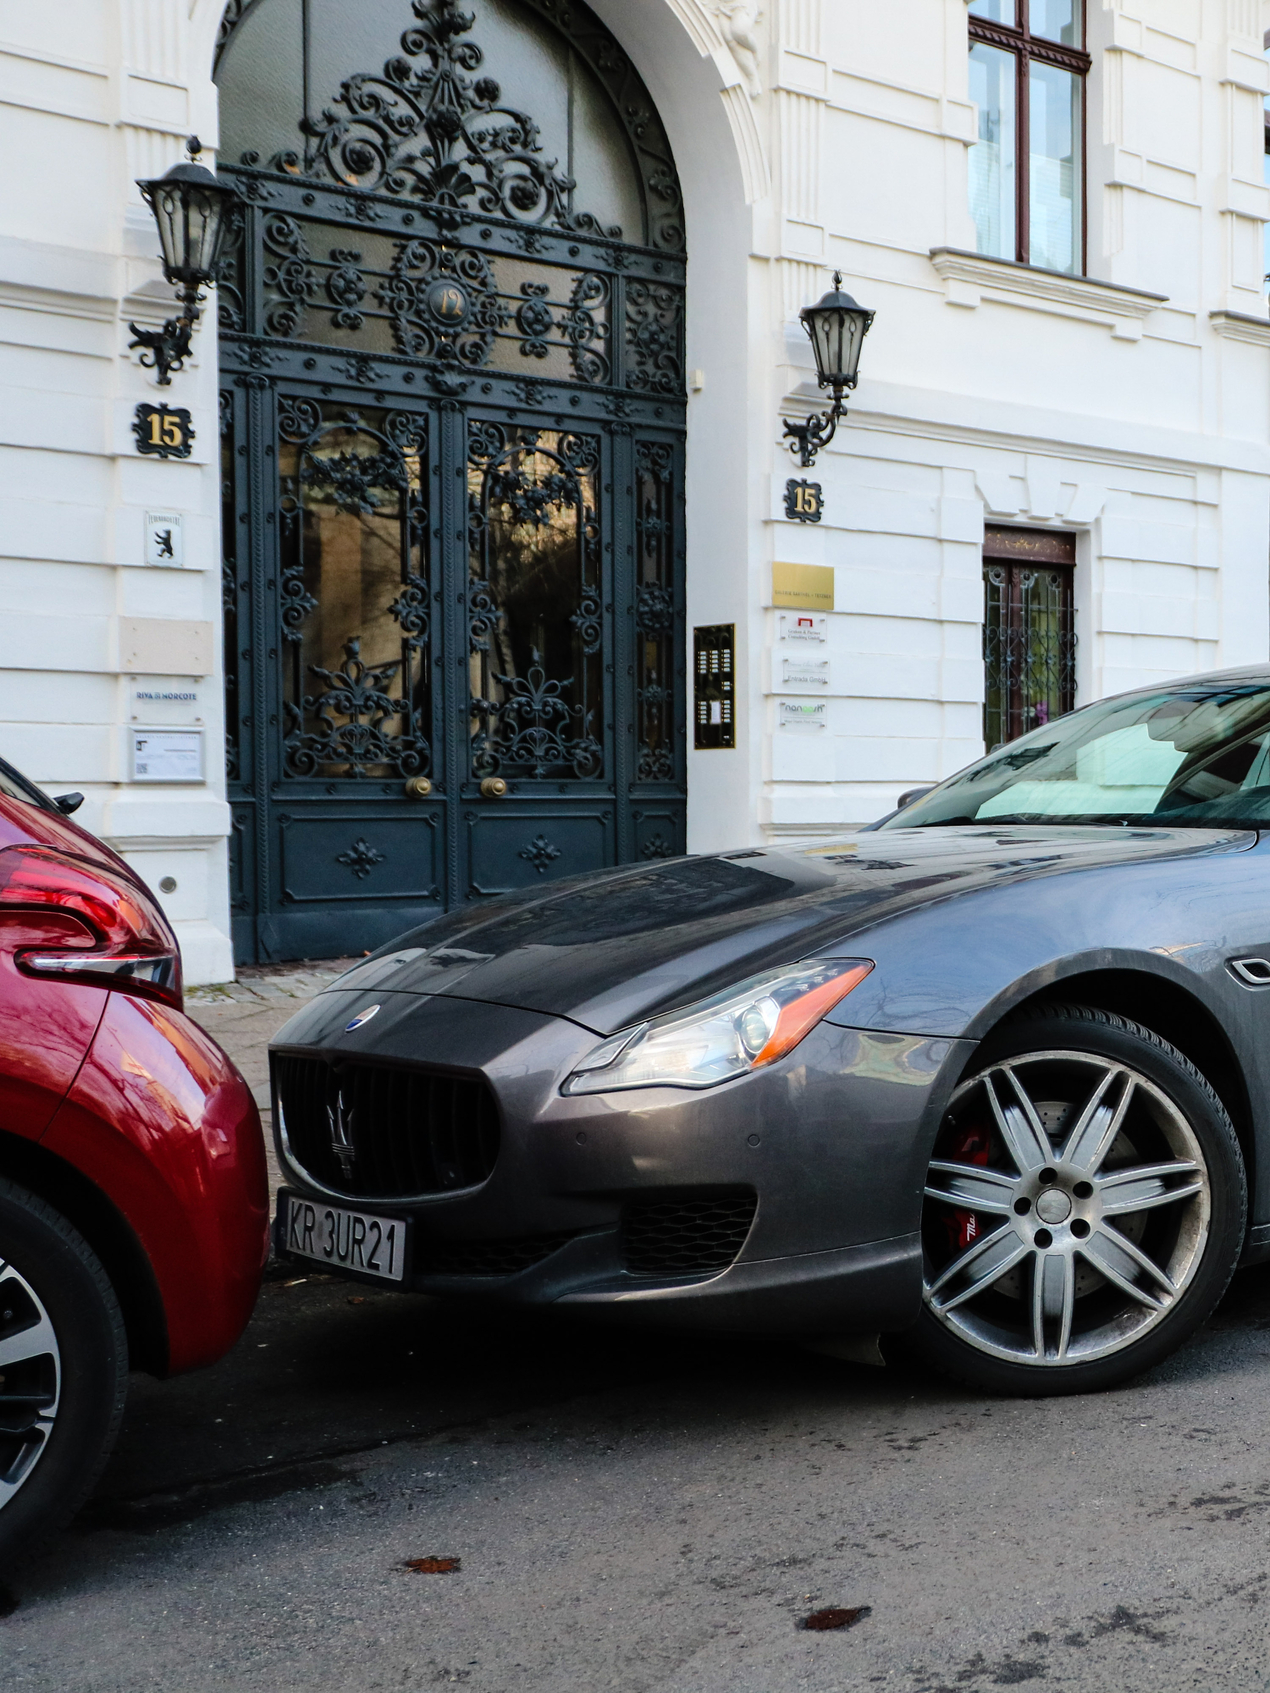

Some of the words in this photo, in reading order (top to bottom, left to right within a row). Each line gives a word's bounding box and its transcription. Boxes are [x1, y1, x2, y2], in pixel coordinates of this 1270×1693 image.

[146, 413, 183, 447] 15
[794, 487, 817, 514] 15
[136, 691, 153, 699] RIVA
[290, 1200, 315, 1254] KR
[323, 1210, 397, 1275] 3UR21
